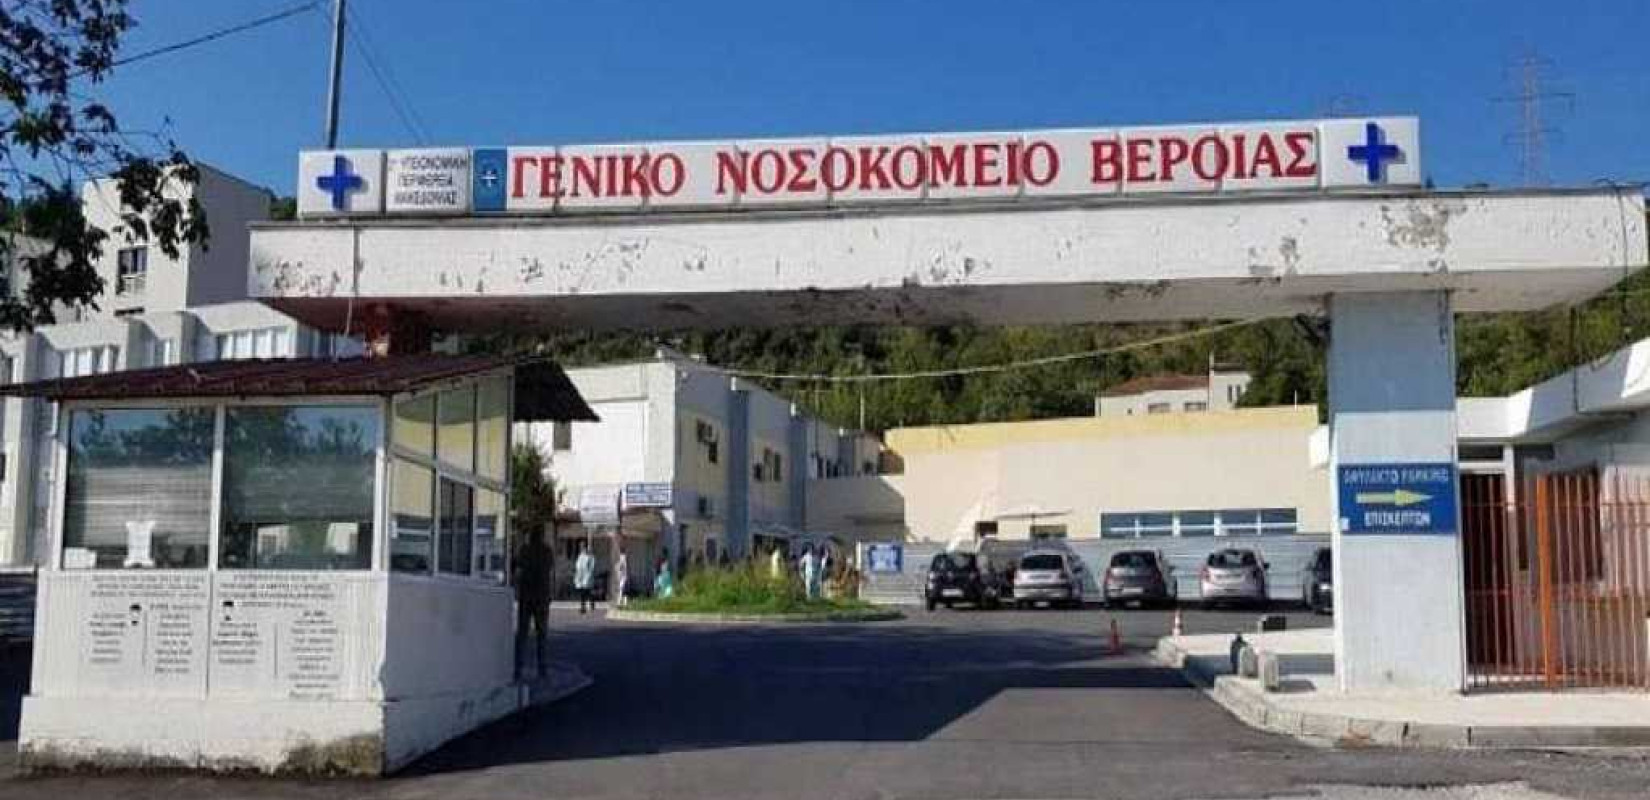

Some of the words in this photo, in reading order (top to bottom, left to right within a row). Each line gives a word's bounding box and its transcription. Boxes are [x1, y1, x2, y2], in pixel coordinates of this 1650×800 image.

[511, 152, 685, 199] ΓΕΝΙΚΟ
[715, 141, 1059, 195] ΝΟΣΟΚΟΜΕΙΟ
[1090, 132, 1317, 184] ΒΕΡΟΙΑΣ
